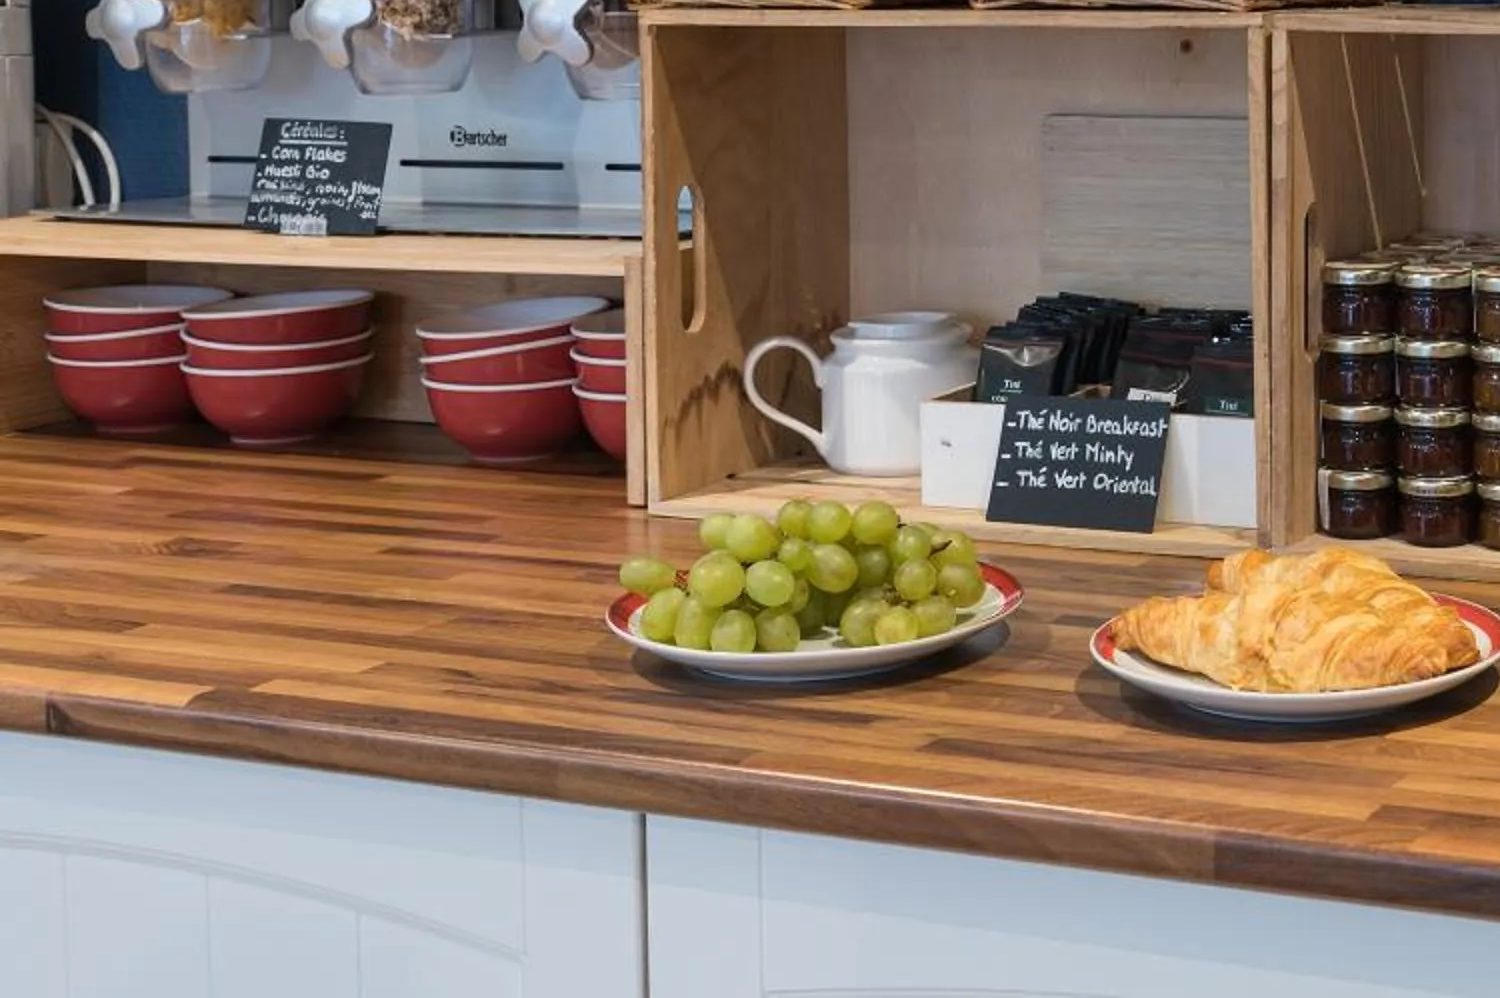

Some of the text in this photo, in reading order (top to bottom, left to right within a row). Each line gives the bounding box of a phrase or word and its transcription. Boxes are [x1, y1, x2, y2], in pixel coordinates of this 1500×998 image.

[271, 146, 300, 160] Corn
[1050, 409, 1082, 433] Noir
[1086, 414, 1168, 438] Breakfast
[1014, 440, 1134, 471] Thé Vert Minty
[1016, 466, 1157, 496] Thé Vert Oriental
